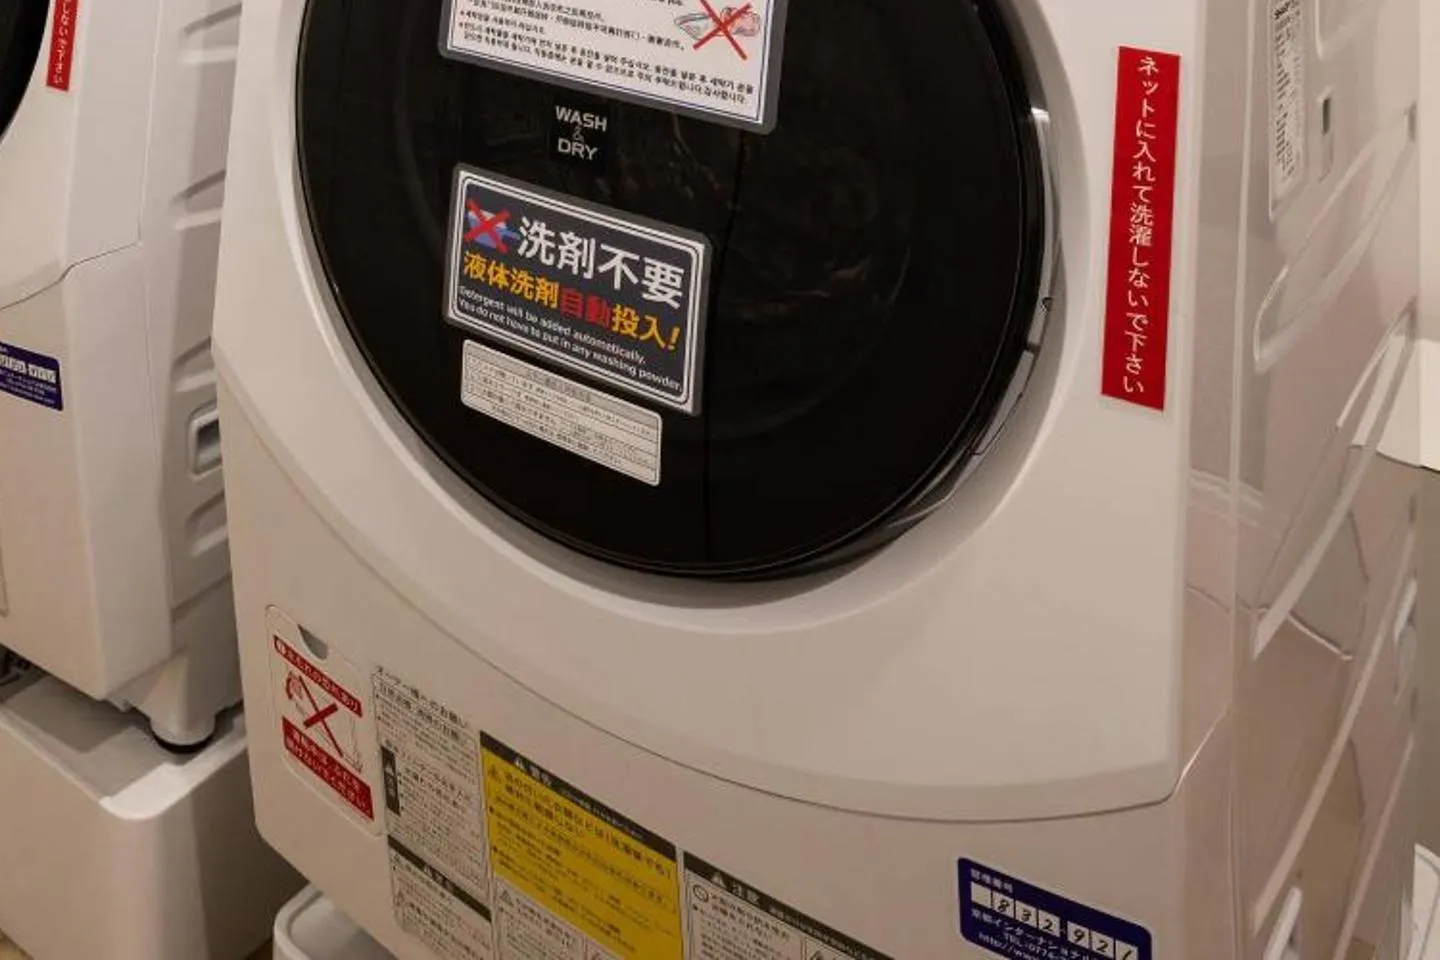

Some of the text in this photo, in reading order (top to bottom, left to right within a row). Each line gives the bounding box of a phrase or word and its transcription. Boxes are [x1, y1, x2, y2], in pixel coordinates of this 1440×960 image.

[554, 105, 607, 133] WASH
[557, 137, 598, 161] DRY
[516, 215, 684, 312] 洗剤不要
[1123, 55, 1160, 396] ネットに入れて洗濯しないで下さい
[462, 250, 680, 355] 液体洗剤自動投入!
[506, 302, 522, 319] will
[525, 309, 538, 325] be
[573, 327, 645, 367] automatically.
[477, 305, 487, 319] do
[489, 309, 504, 325] not
[506, 316, 529, 335] have
[541, 330, 558, 347] put
[571, 341, 590, 360] any
[593, 350, 636, 377] washing
[639, 367, 682, 396] powder.
